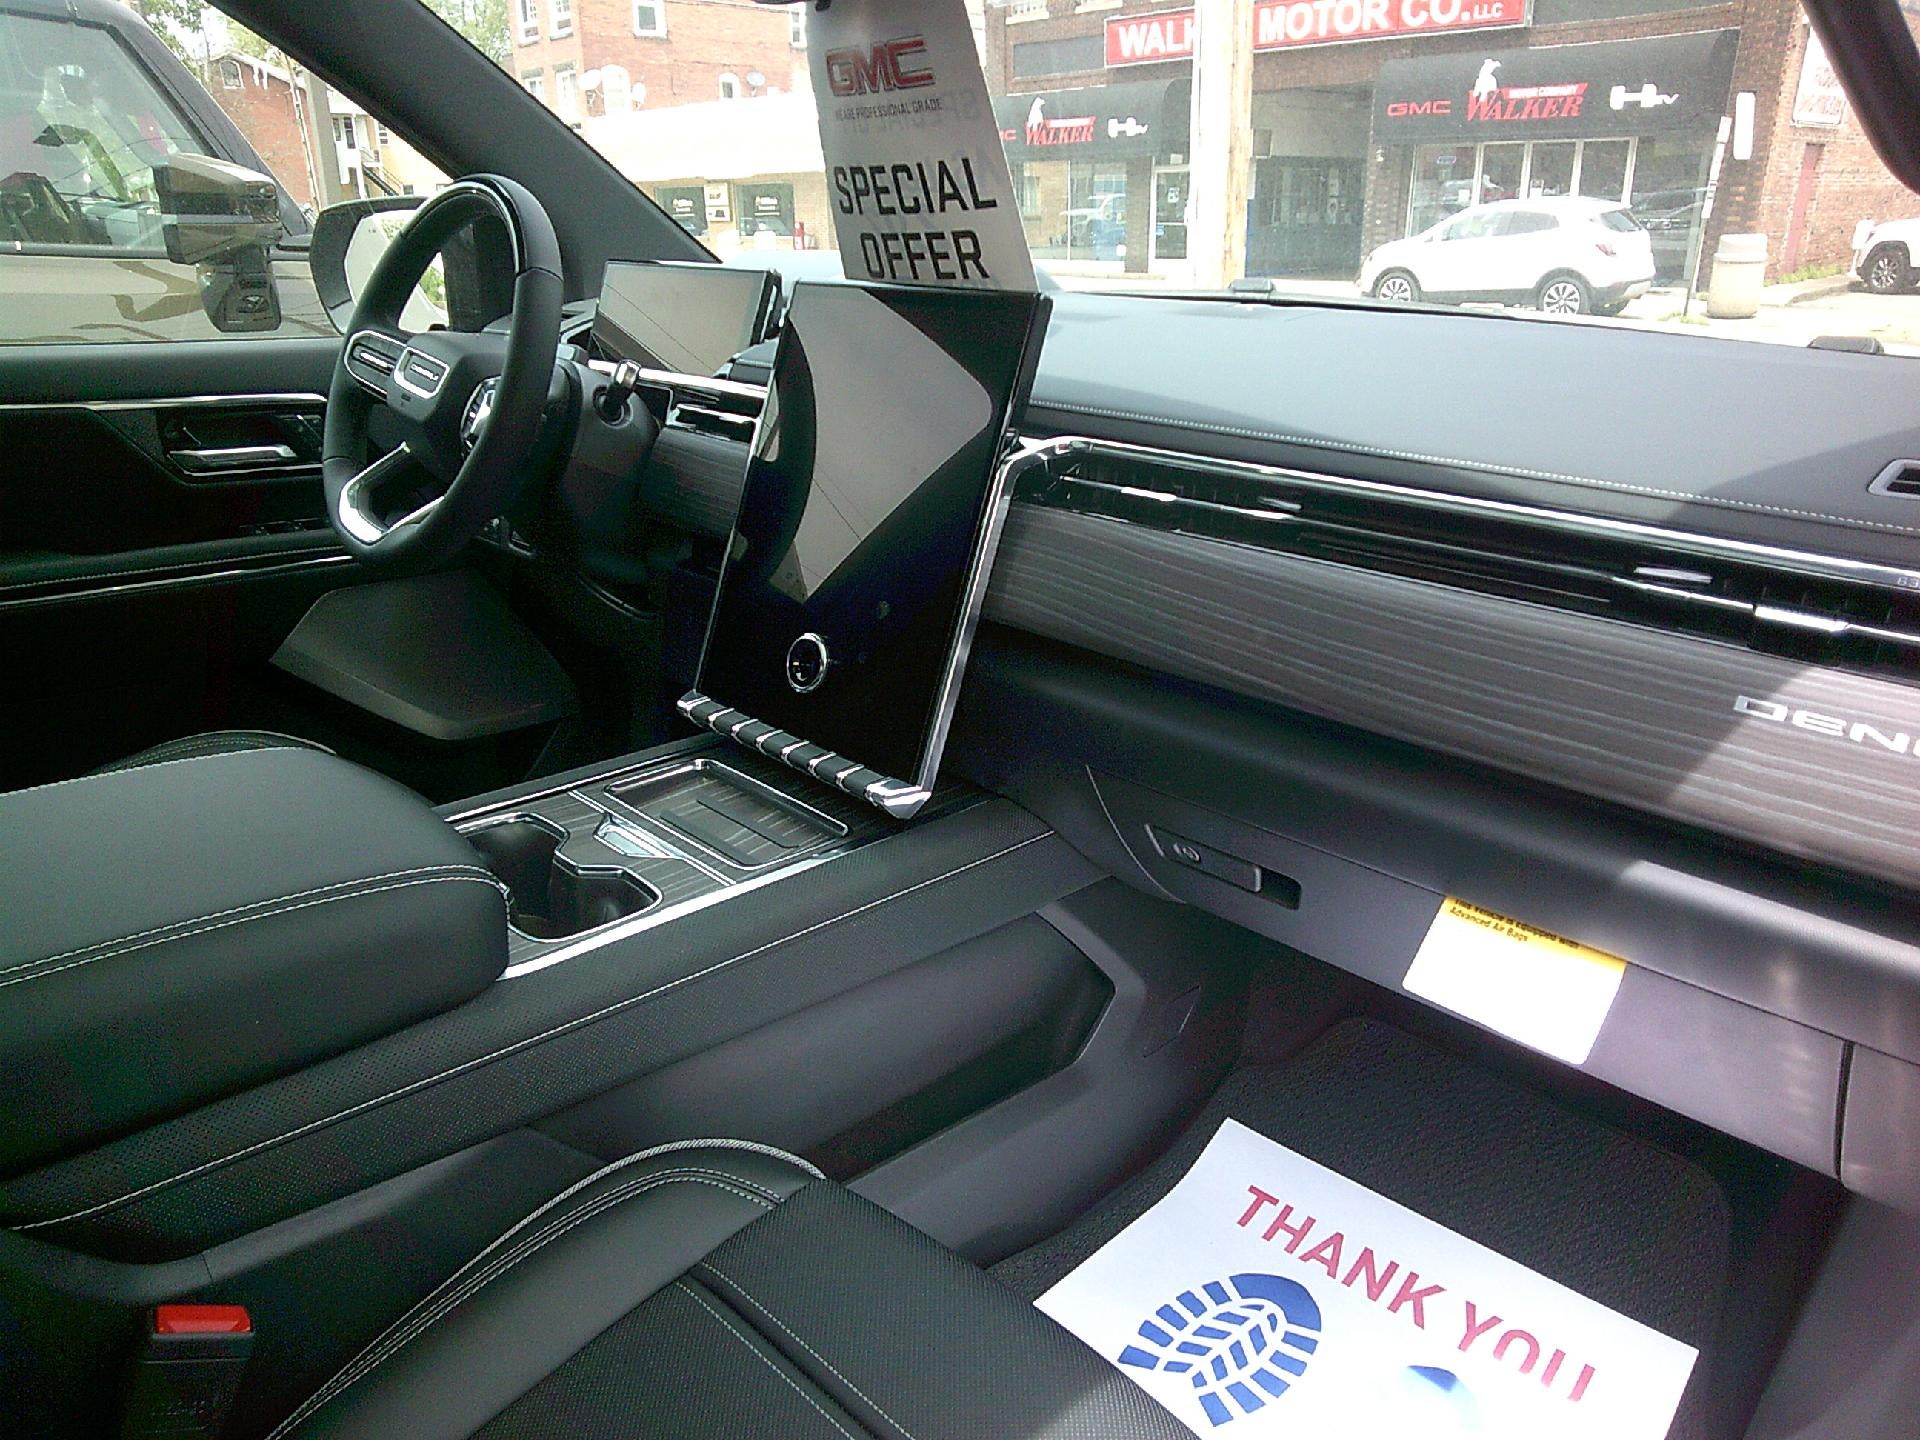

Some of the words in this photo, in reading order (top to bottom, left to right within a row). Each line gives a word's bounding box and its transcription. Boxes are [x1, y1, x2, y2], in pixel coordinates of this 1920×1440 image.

[1258, 0, 1389, 42] MOTOR
[825, 34, 936, 97] GMC
[911, 98, 944, 113] GRADE
[1386, 100, 1452, 117] GMC
[1467, 90, 1584, 121] WALKER
[1025, 121, 1095, 145] WALKER
[833, 157, 998, 215] SPECIAL
[860, 229, 990, 280] OFFER
[1733, 695, 1920, 758] DEN
[1236, 1184, 1447, 1331] THANK
[1457, 1300, 1596, 1403] YOU
